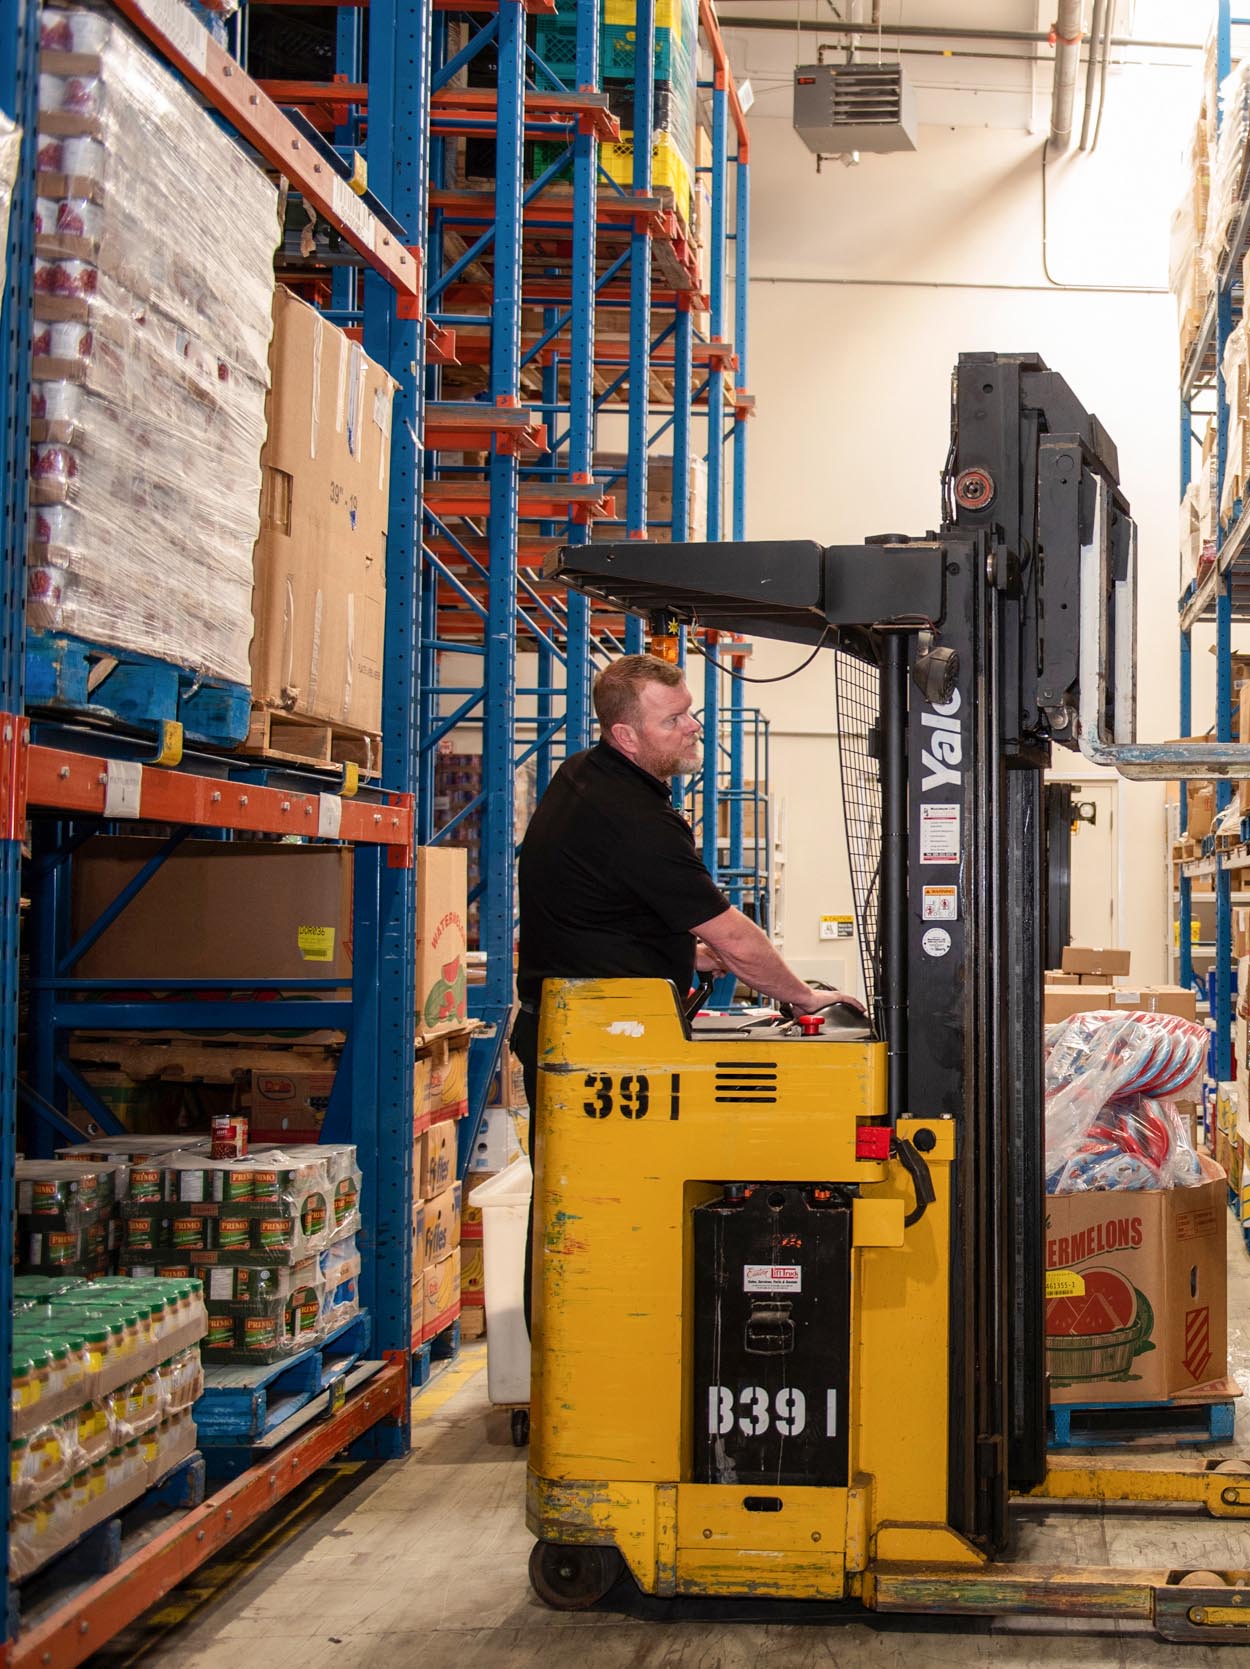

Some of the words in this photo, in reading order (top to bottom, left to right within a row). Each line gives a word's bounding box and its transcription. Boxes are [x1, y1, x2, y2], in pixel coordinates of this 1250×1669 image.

[132, 1171, 159, 1182] PRIMO
[231, 1172, 253, 1182] PRIM
[261, 1221, 289, 1231] PRIMO
[1047, 1217, 1143, 1268] ERMELONS
[708, 1386, 838, 1437] B391
